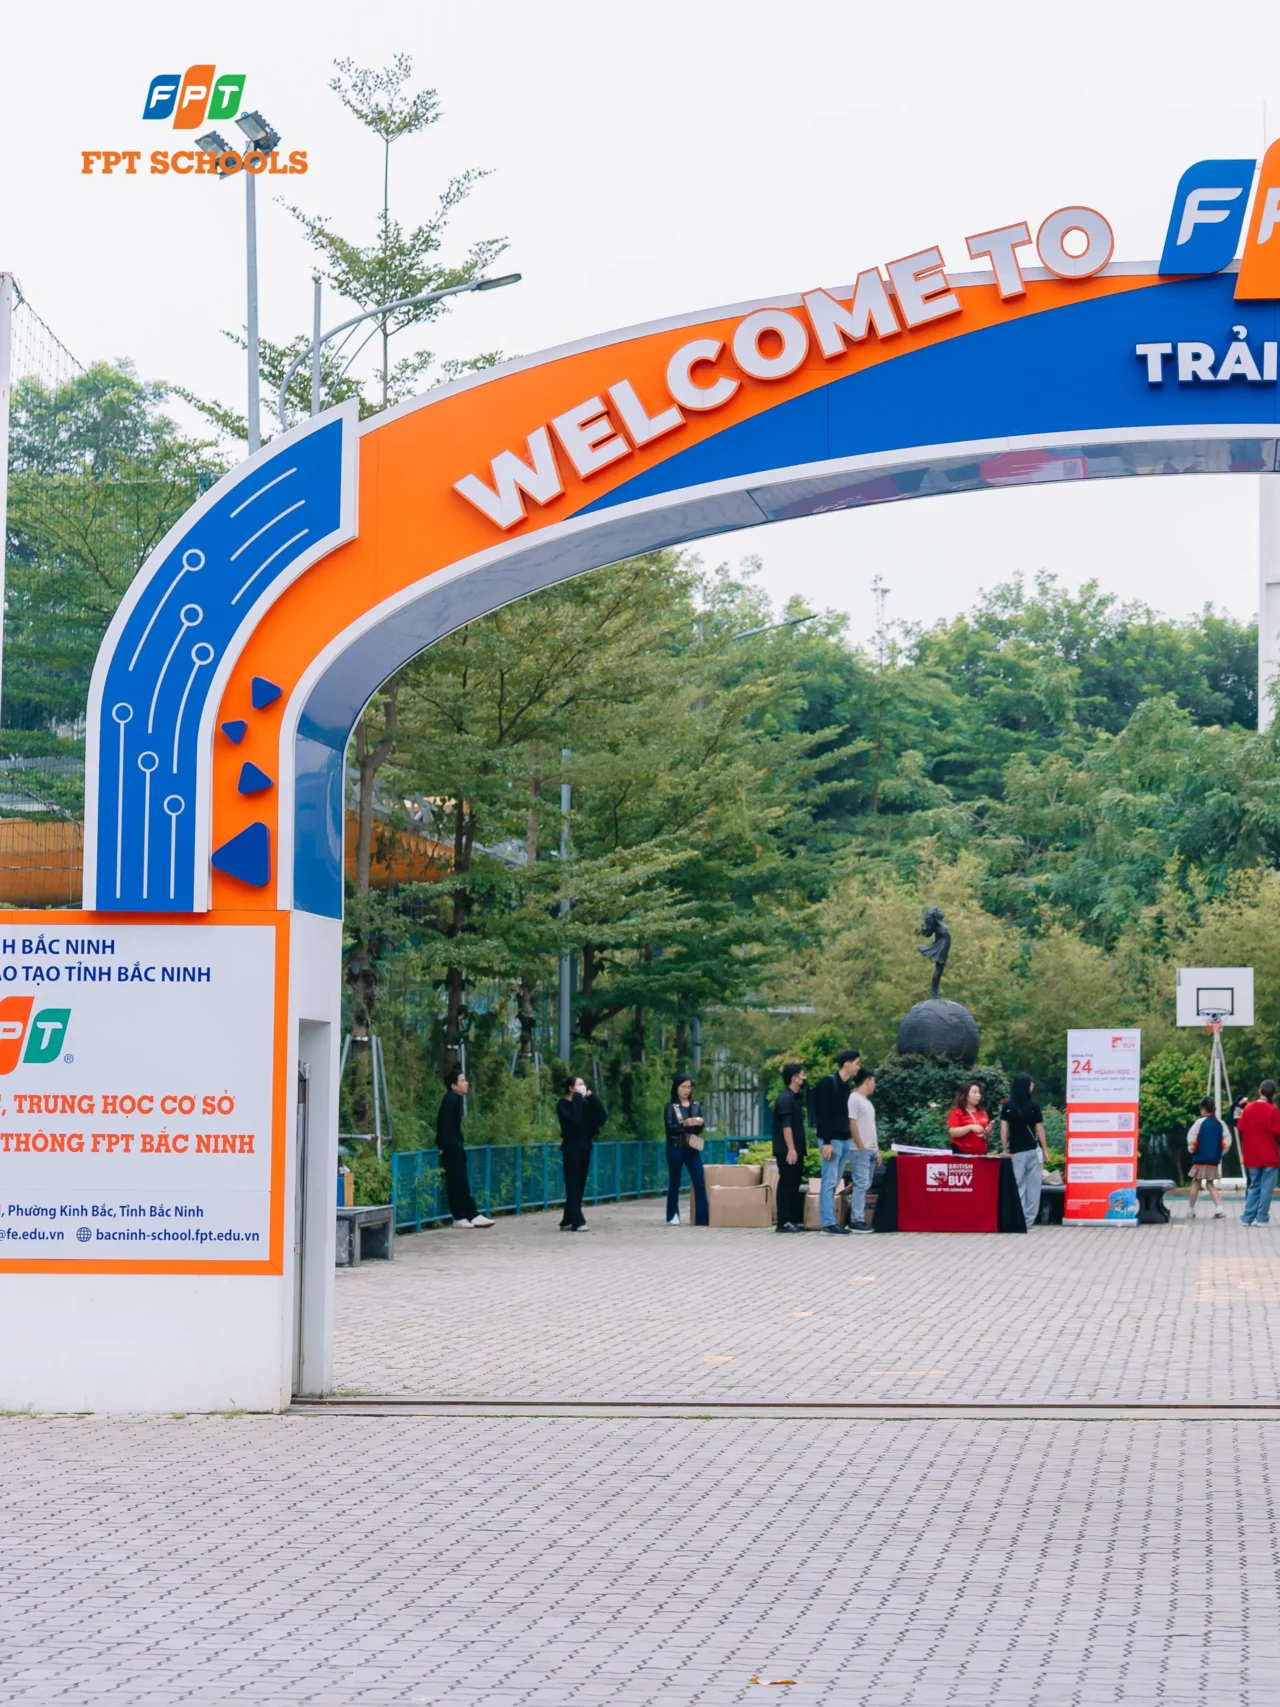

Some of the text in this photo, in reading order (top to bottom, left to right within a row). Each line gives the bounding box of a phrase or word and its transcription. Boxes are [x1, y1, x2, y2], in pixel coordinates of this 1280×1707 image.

[1136, 324, 1279, 384] TRẢI
[452, 205, 1114, 531] WELCOME TO
[21, 934, 60, 955] BẮC
[65, 939, 115, 955] NINH
[22, 965, 60, 986] TẠO
[65, 961, 111, 982] TỈNH
[117, 961, 156, 983] BẮC
[161, 966, 211, 983] NINH
[1072, 1059, 1093, 1075] 24
[13, 1094, 96, 1115] TRUNG
[101, 1094, 154, 1119] HỌC
[160, 1094, 197, 1115] CƠ
[201, 1089, 236, 1115] SỞ
[0, 1126, 255, 1154] THÔNG FPT BẮC NINH
[948, 1175, 973, 1186] BUV
[8, 1204, 57, 1220] Phường
[60, 1204, 88, 1217] Kinh
[92, 1203, 117, 1219] Bắc,
[119, 1203, 146, 1217] Tỉnh
[149, 1203, 171, 1217] Bắc
[174, 1204, 204, 1217] Ninh
[96, 1229, 260, 1244] bacninh-school.fpt.edu.vn
